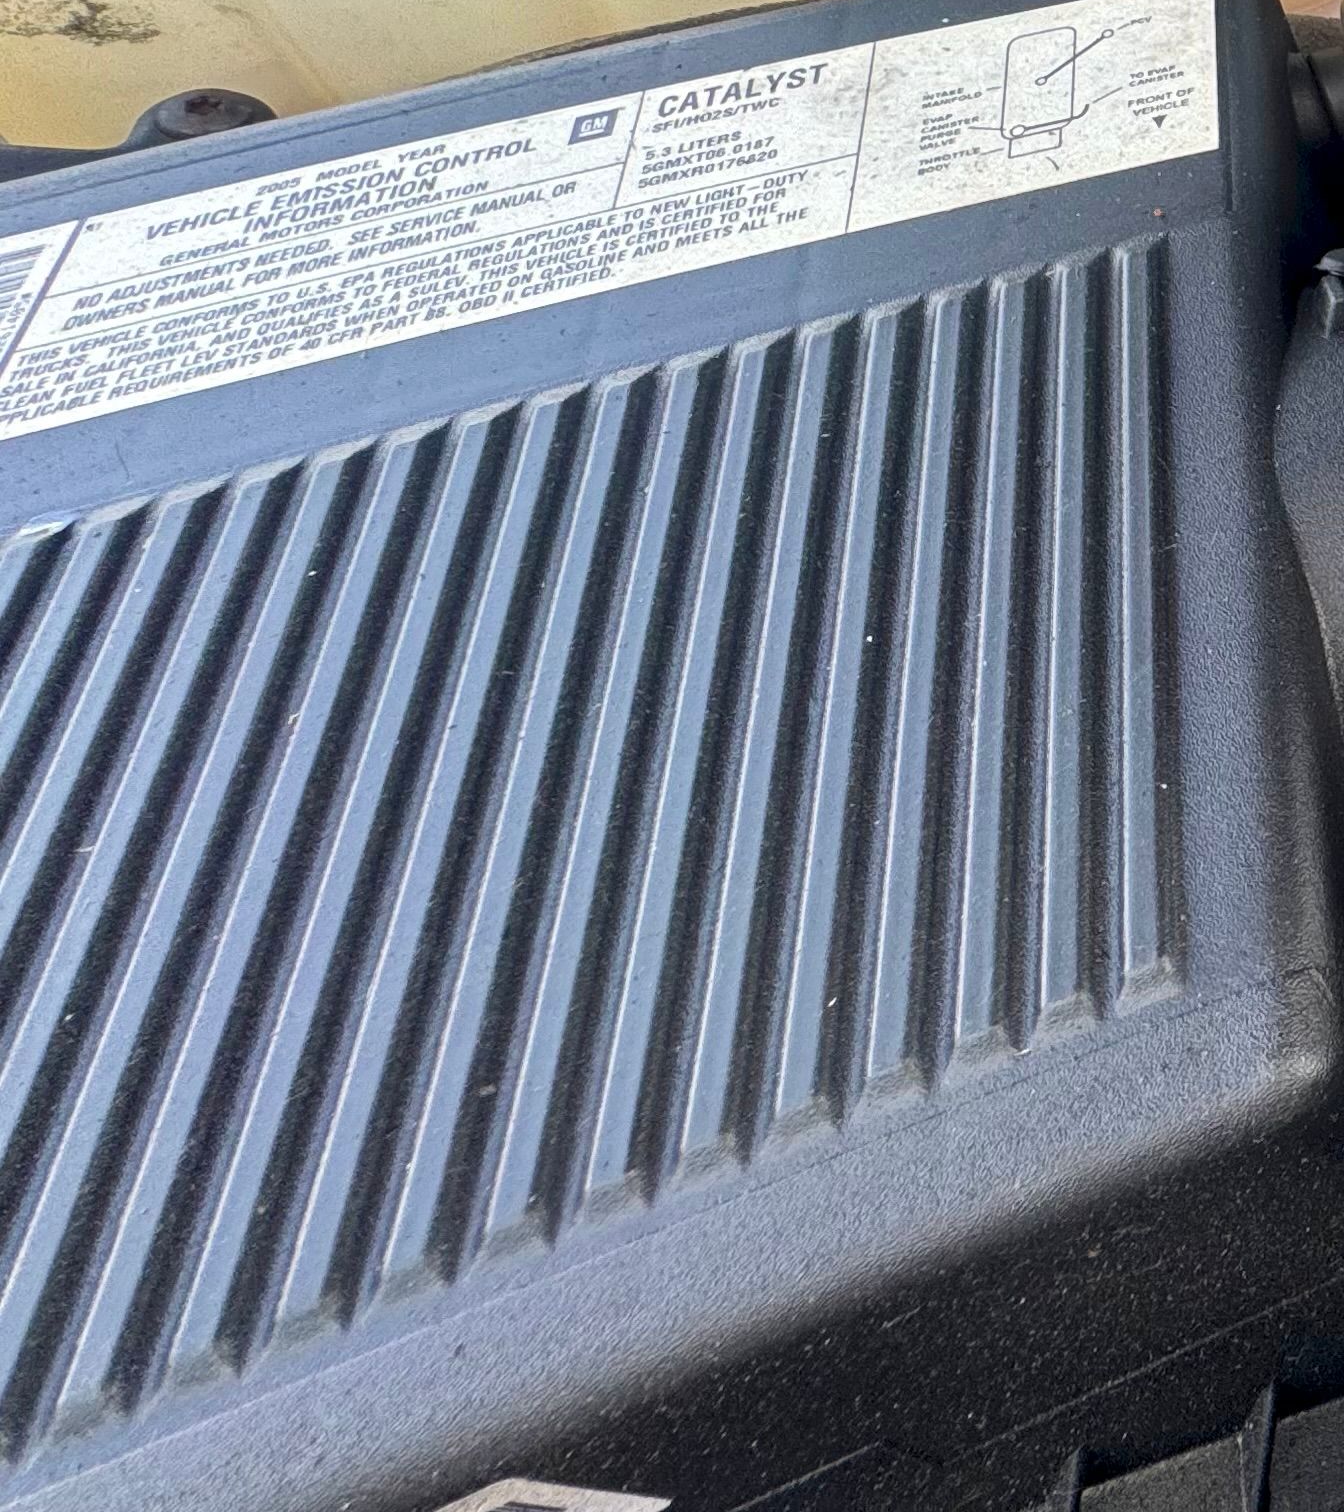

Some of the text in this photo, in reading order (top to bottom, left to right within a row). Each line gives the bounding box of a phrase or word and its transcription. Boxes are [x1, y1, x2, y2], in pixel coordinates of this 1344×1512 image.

[657, 61, 827, 119] CATALYST
[678, 130, 741, 153] LITERS
[1129, 91, 1170, 108] FRONT
[1133, 97, 1188, 117] VEHICLE
[144, 137, 538, 240] VEHICLE EMISSION CONTROL
[243, 176, 437, 232] INFORMATION
[256, 144, 445, 194] 2005 MODEL YEAR
[62, 298, 150, 330] OWNERS
[154, 278, 236, 308] MANUAL
[242, 267, 282, 286] FOR
[287, 252, 342, 276] MORE
[348, 219, 482, 262] INFORMATION.
[73, 181, 575, 310] NO ADJUSTMENTS NEEDED. SEE SERVICE MANUAL OR
[160, 181, 488, 265] GENERAL MOTORS CORPORATION
[0, 201, 778, 397] SALE AND QUALIFIES AS SULEV. THIS VEHICLE IS CERTIFIED TO THE
[9, 187, 786, 382] TRUCKS. THIS VEHICLE CONFORMS TO FEDERAL REGULATIONS AND CERTIFIED FOR
[17, 197, 689, 366] THIS VEHICLE CONFORMS TO EPA REGULATIONS APPLICABLE TO NEW
[62, 375, 111, 396] FUEL
[117, 359, 174, 383] FLEET
[180, 349, 217, 367] LEV
[223, 320, 336, 357] STANDARDS
[344, 304, 399, 327] WHEN
[406, 280, 501, 312] OPERATED
[508, 272, 533, 287] ON
[540, 249, 626, 279] GASOLINE
[633, 240, 668, 257] AND
[676, 225, 732, 247] MEETS
[740, 216, 768, 232] ALL
[777, 207, 807, 223] THE
[108, 352, 261, 399] REQUIREMENTS
[268, 344, 293, 359] OF
[327, 327, 363, 345] CFR
[371, 313, 418, 334] PART
[459, 294, 496, 312] OBD
[521, 265, 616, 297] CERTIFIED.
